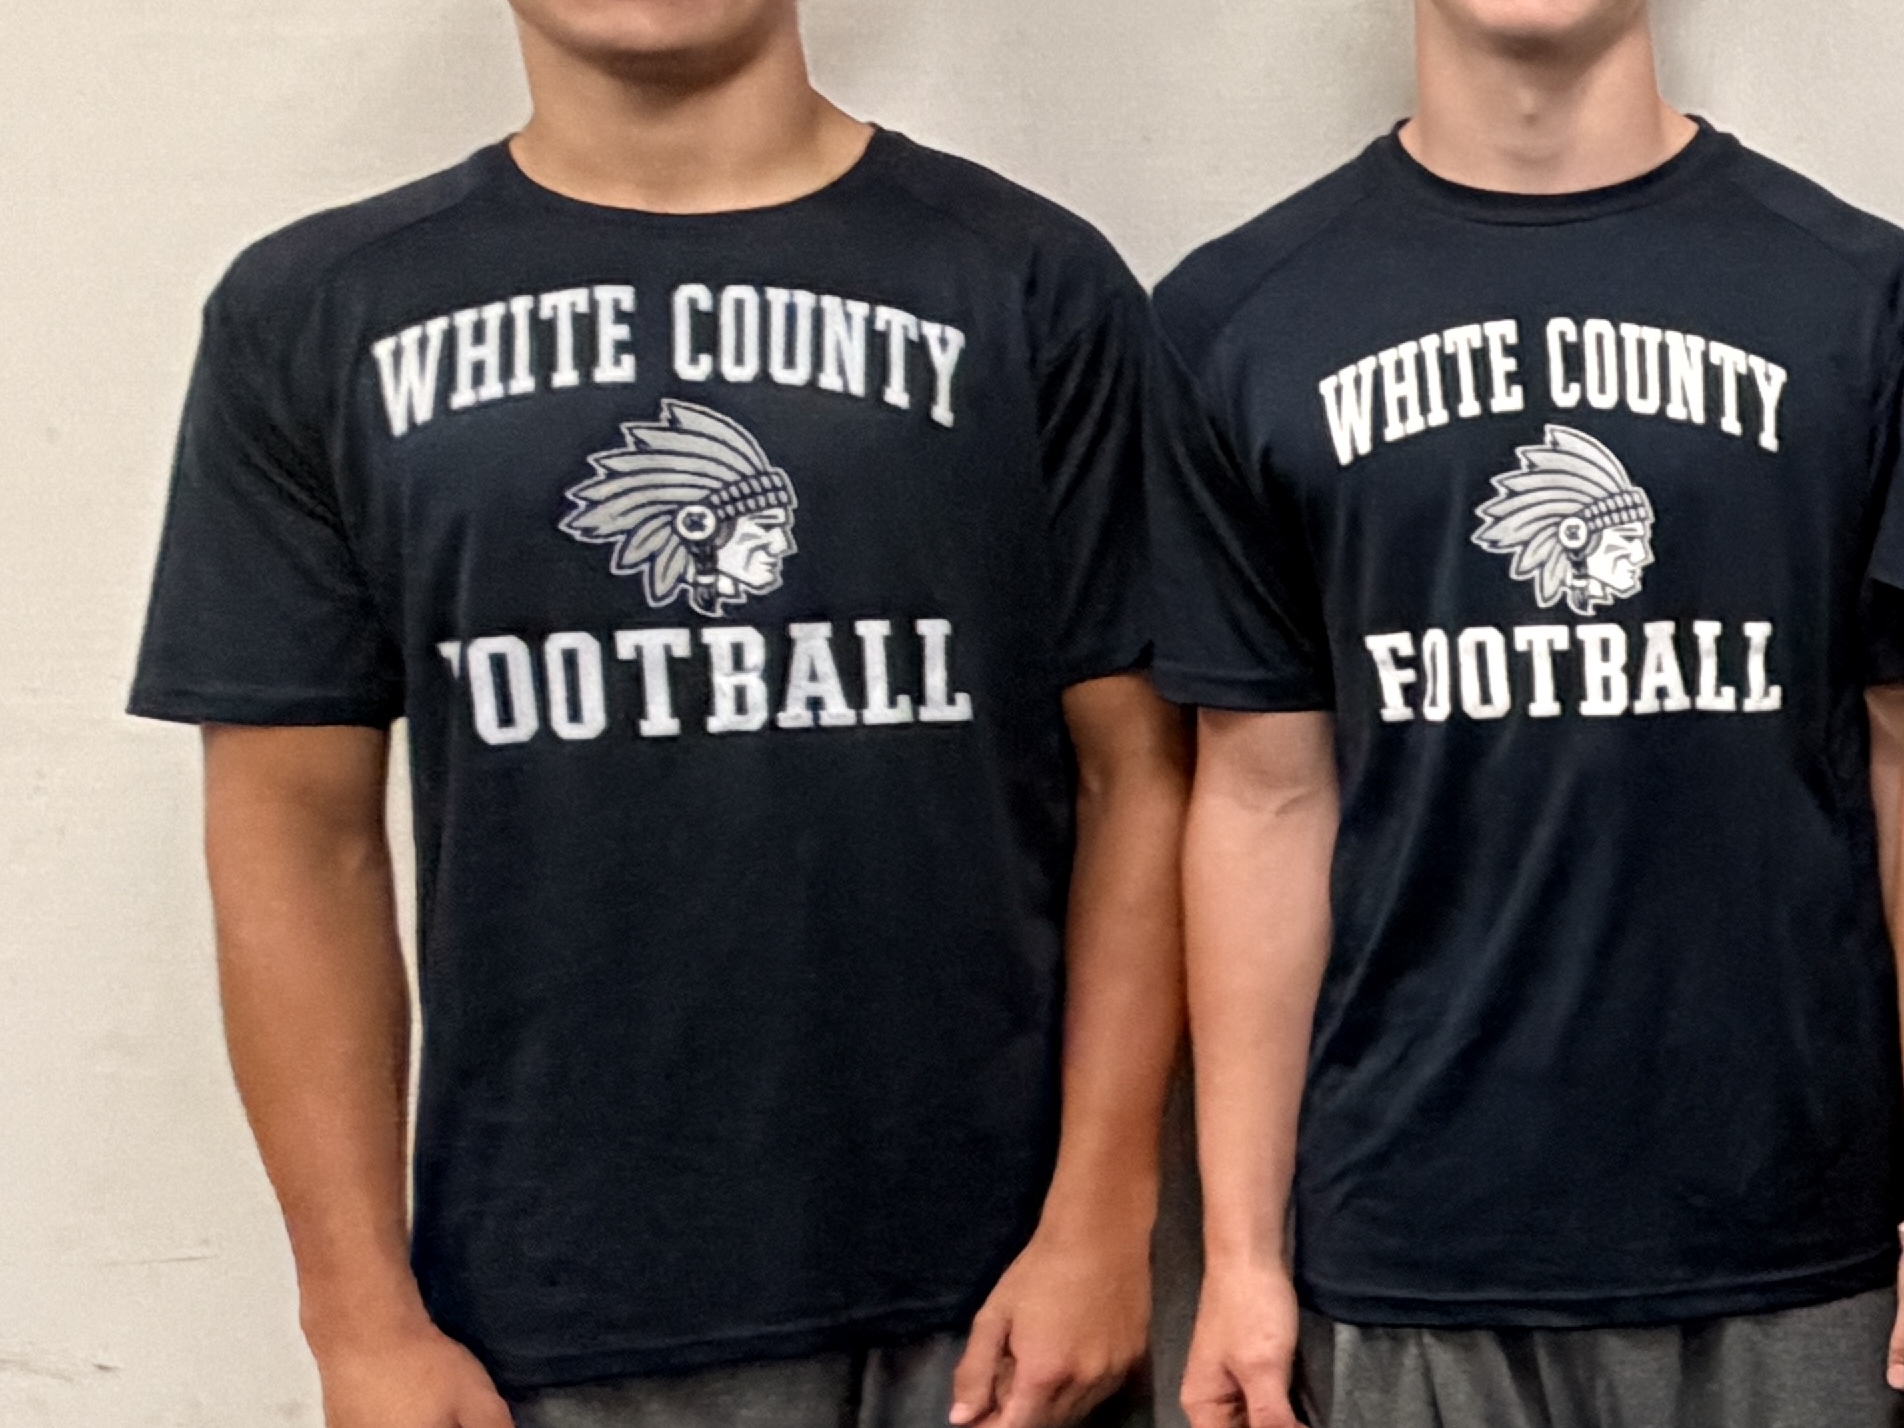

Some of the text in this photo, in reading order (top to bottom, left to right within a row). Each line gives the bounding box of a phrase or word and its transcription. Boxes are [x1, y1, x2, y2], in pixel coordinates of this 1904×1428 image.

[372, 283, 965, 437] WHITE COUNTY
[1319, 317, 1787, 465] WHITE COUNTY
[436, 619, 973, 745] OOTBALL
[1365, 620, 1781, 721] FOOTBALL
